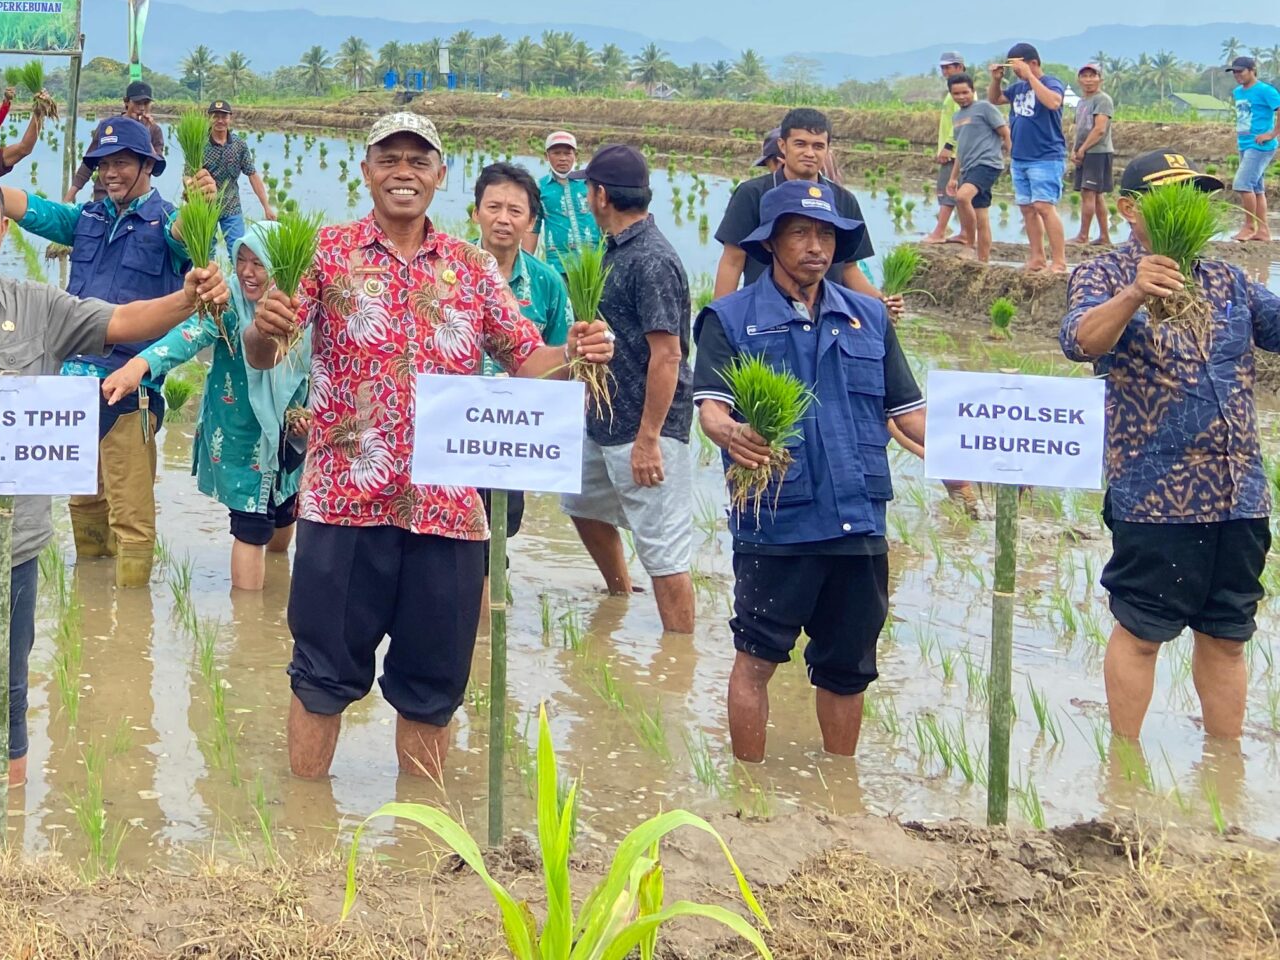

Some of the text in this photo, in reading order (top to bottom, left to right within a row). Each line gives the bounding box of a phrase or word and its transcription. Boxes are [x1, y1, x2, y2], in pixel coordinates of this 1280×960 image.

[24, 410, 86, 427] TPHP
[465, 407, 545, 426] CAMAT
[958, 402, 1085, 425] KAPOLSEK
[14, 444, 80, 461] BONE
[446, 438, 561, 460] LIBURENG
[960, 434, 1081, 456] LIBURENG
